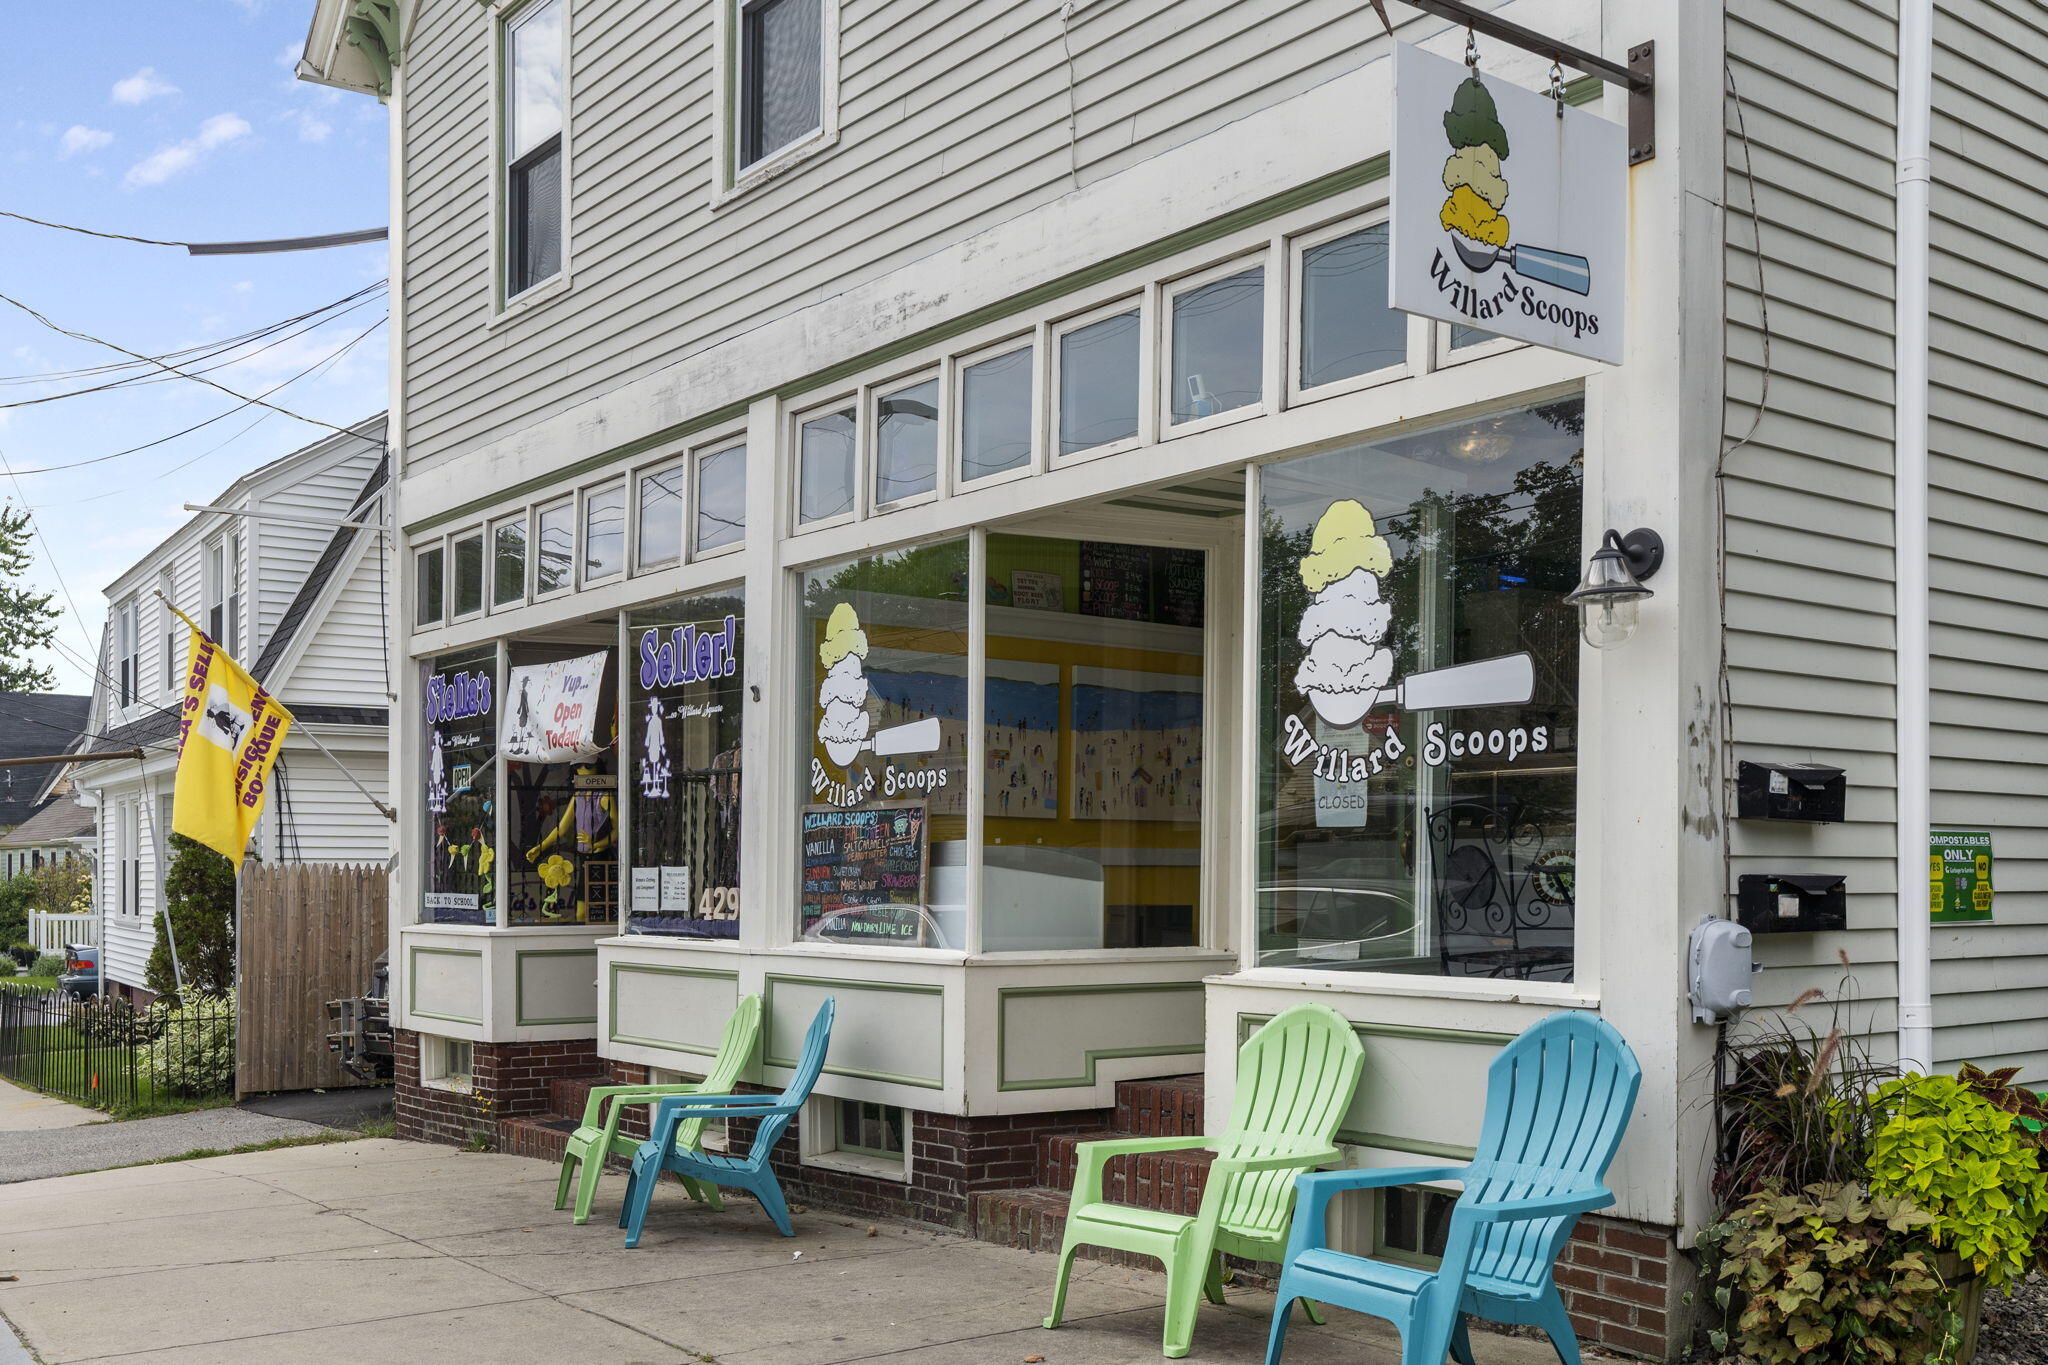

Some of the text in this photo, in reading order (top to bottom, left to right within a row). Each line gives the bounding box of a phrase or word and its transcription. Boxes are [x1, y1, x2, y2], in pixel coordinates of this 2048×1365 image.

[1430, 247, 1599, 338] Willard Scoops
[640, 614, 735, 690] Seller!
[426, 671, 491, 724] Stella's
[554, 702, 582, 728] Open
[546, 724, 583, 753] Today!
[1283, 713, 1406, 783] Willard
[1423, 722, 1548, 767] Scoops
[586, 778, 607, 786] OPEN
[811, 757, 947, 808] Willard Scoops
[1318, 796, 1365, 809] CLOSED
[804, 811, 876, 829] WILLARD SCOOPS
[806, 838, 835, 856] VANILLA
[1929, 836, 1990, 845] OMPOSTABLES
[1944, 849, 1973, 860] ONLY
[1978, 862, 1987, 872] NO
[426, 896, 440, 905] BACK
[444, 896, 451, 905] TO
[699, 886, 740, 921] 429
[880, 921, 896, 934] LIME
[901, 924, 914, 936] ICE
